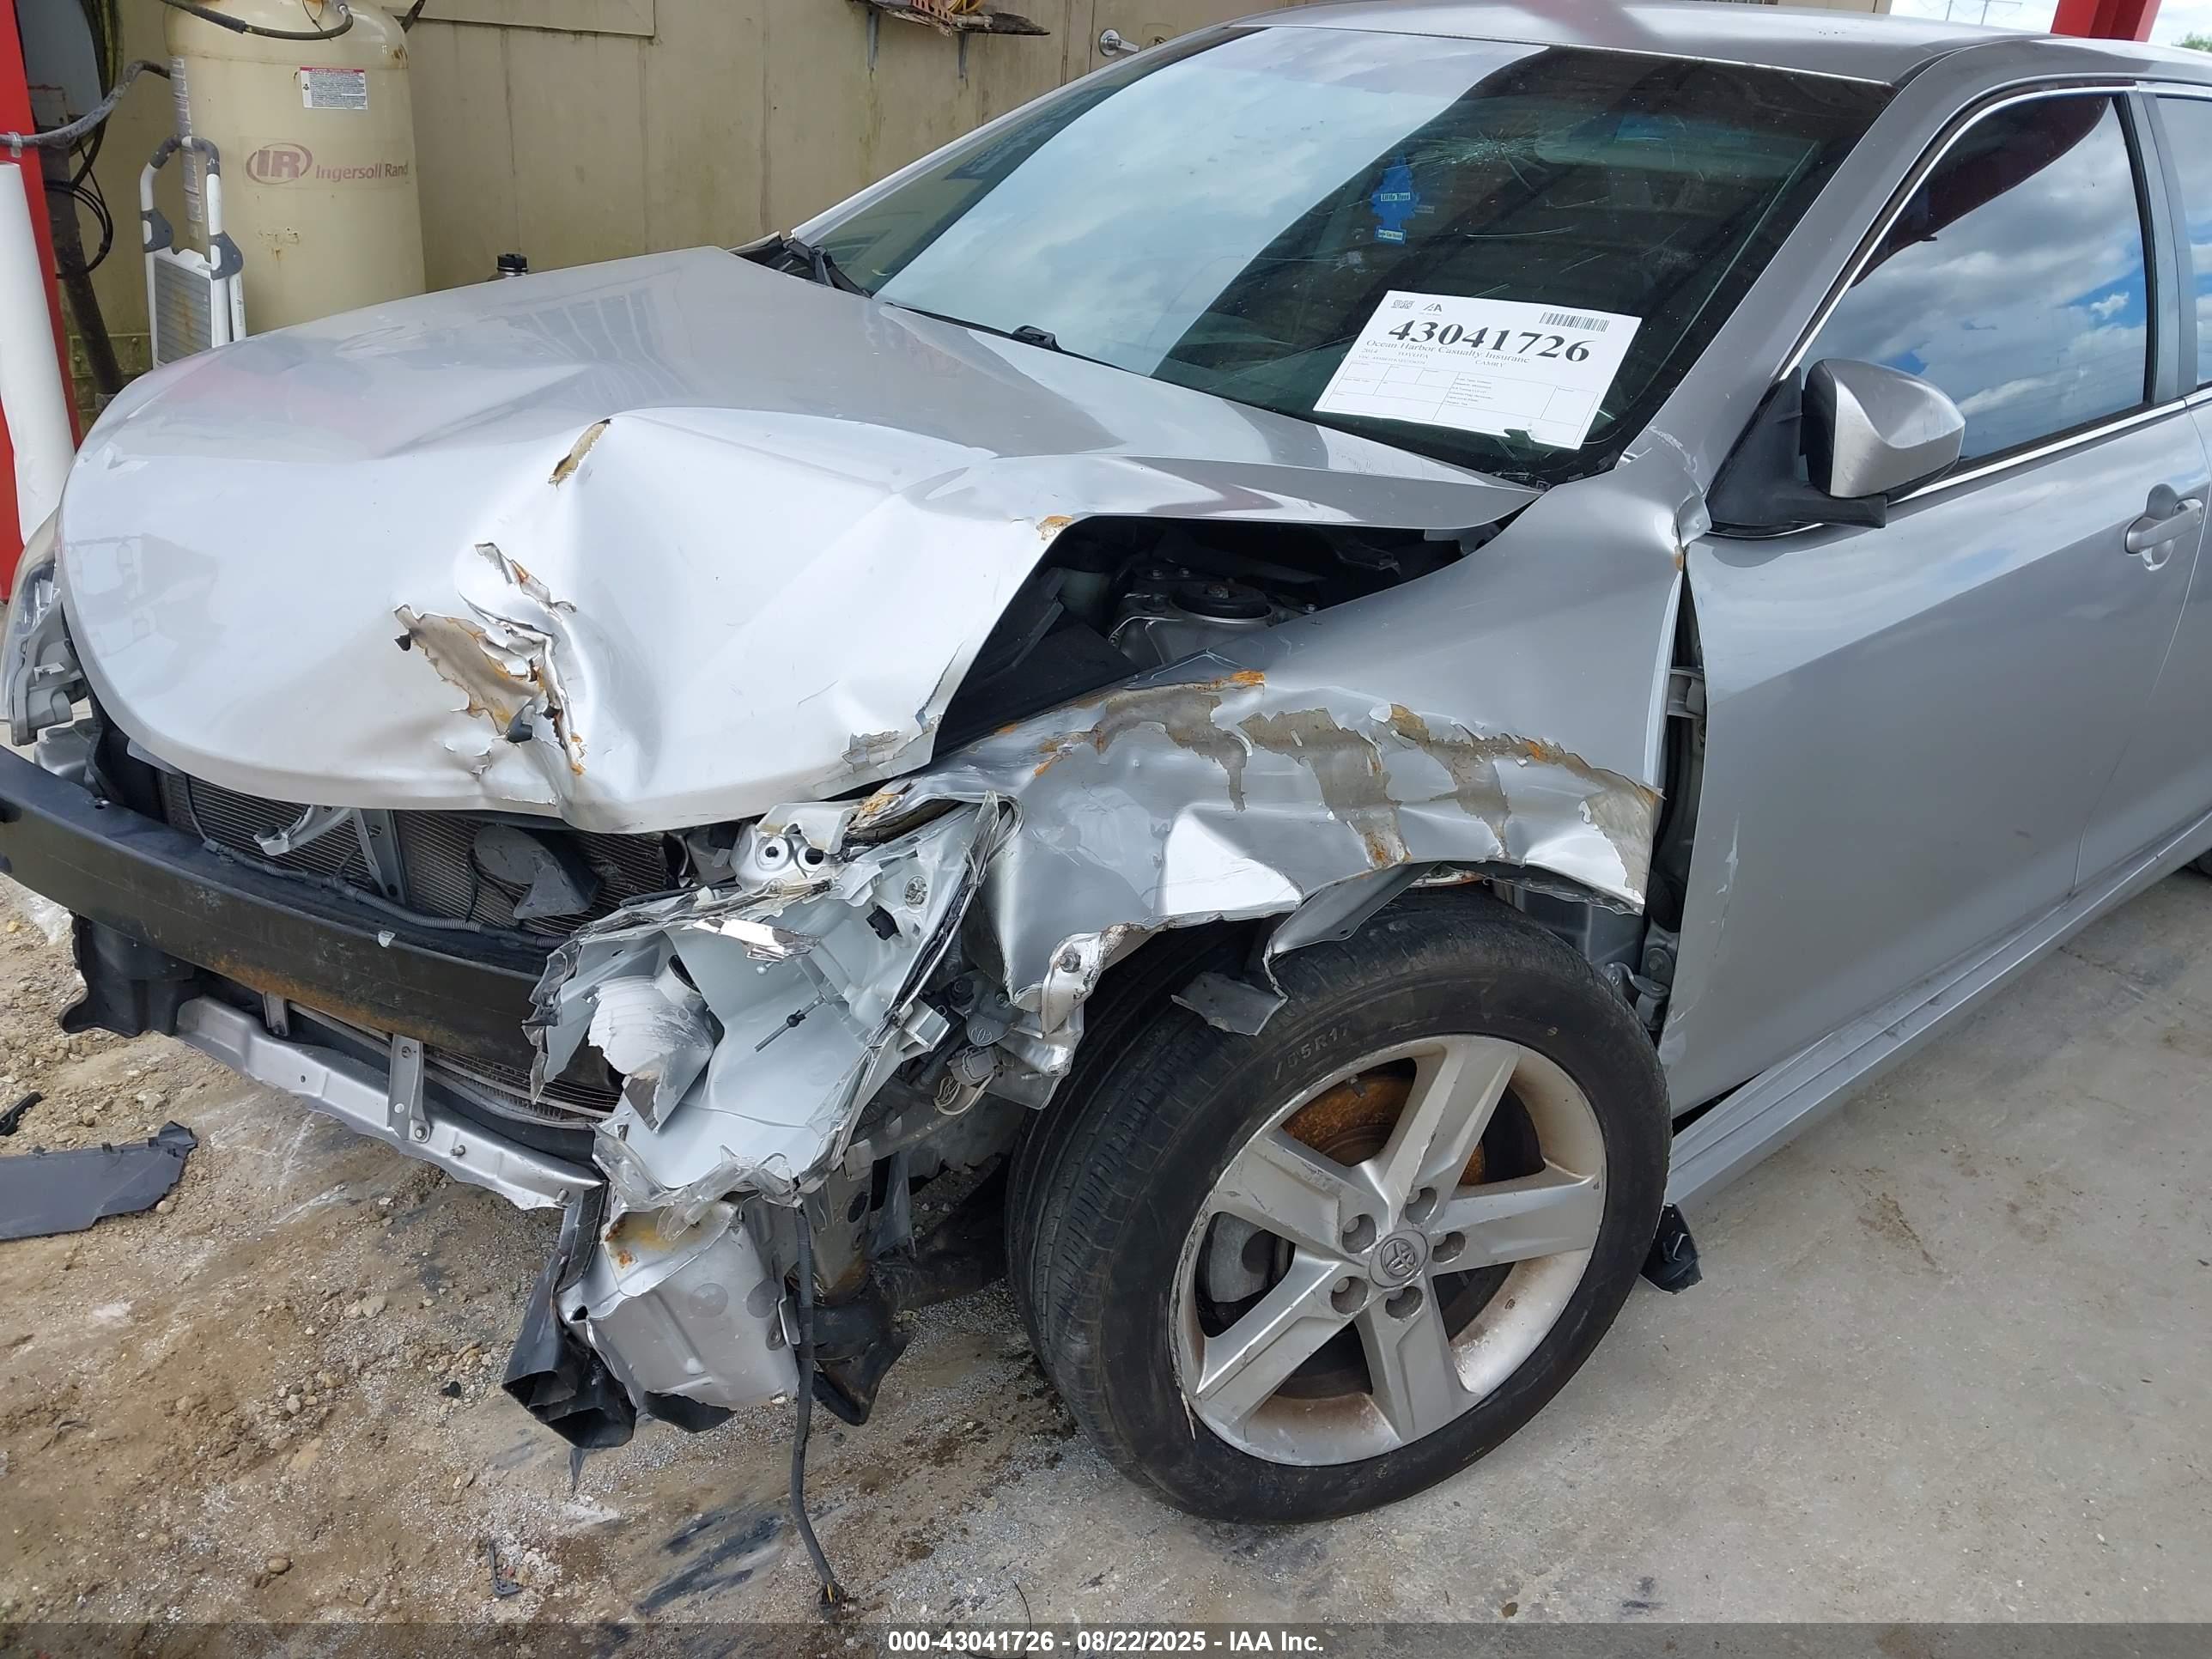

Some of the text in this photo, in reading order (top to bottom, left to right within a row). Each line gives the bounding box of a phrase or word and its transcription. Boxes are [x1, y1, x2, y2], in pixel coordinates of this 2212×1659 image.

[315, 163, 382, 183] Ingersoll
[384, 161, 409, 178] Rand
[1366, 339, 1397, 349] Ocean
[1400, 342, 1437, 353] Harbor
[1438, 345, 1483, 359] Casualty
[1389, 319, 1599, 362] 43041726
[1398, 350, 1429, 360] TOYOTA
[1474, 359, 1505, 368] CAMRY
